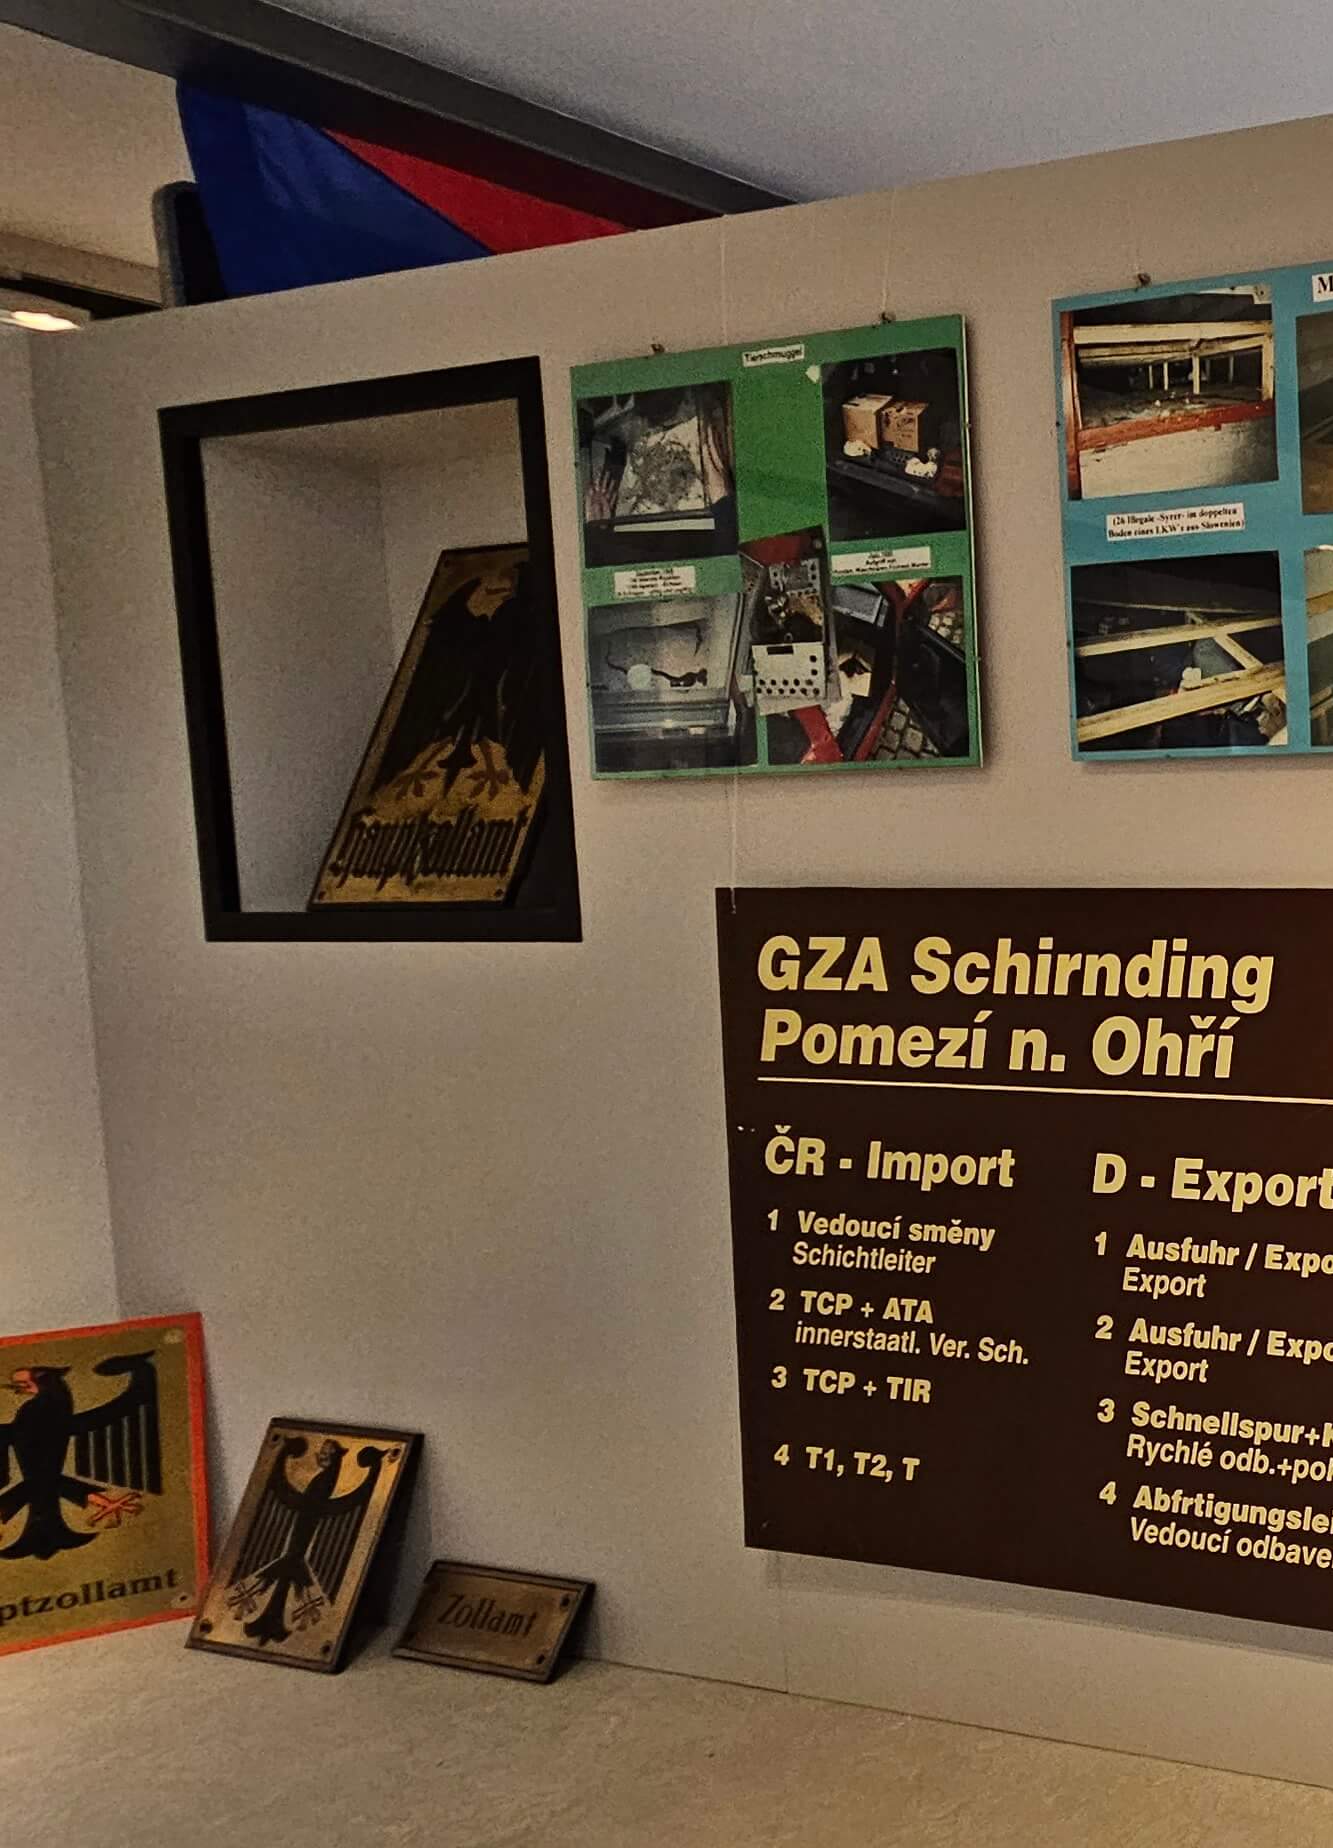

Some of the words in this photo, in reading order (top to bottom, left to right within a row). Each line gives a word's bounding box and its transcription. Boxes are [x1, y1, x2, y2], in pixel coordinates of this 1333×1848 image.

[758, 935, 888, 991] GZA
[911, 937, 1274, 1013] Schirnding
[761, 1009, 992, 1068] Pomezí
[1009, 1029, 1065, 1072] n.
[1092, 1015, 1240, 1078] Ohří
[765, 1125, 825, 1176] ČR
[867, 1141, 1015, 1191] Import
[1093, 1153, 1126, 1193] D
[768, 1209, 778, 1230] 1
[798, 1210, 902, 1239] Vedoucí
[909, 1219, 995, 1251] směny
[793, 1241, 936, 1273] Schichtleiter
[1095, 1232, 1106, 1255] 1
[1126, 1234, 1239, 1265] Ausfuhr
[1123, 1267, 1206, 1299] Export
[769, 1289, 785, 1310] 2
[800, 1291, 853, 1315] TCP
[883, 1298, 933, 1323] ATA
[796, 1321, 920, 1354] innerstaatl.
[930, 1333, 969, 1358] Ver.
[978, 1337, 1028, 1364] Sch.
[1095, 1315, 1113, 1339] 2
[1128, 1318, 1242, 1351] Ausfuhr
[772, 1366, 787, 1388] 3
[803, 1369, 855, 1394] TCP
[887, 1377, 931, 1403] TIR
[1125, 1351, 1208, 1384] Export
[1097, 1398, 1115, 1423] 3
[774, 1444, 789, 1465] 4
[806, 1447, 844, 1477] T1,
[854, 1452, 893, 1482] T2,
[902, 1457, 920, 1480] T
[1127, 1434, 1213, 1467] Rychlé
[1099, 1481, 1116, 1504] 4
[1131, 1517, 1232, 1553] Vedoucí
